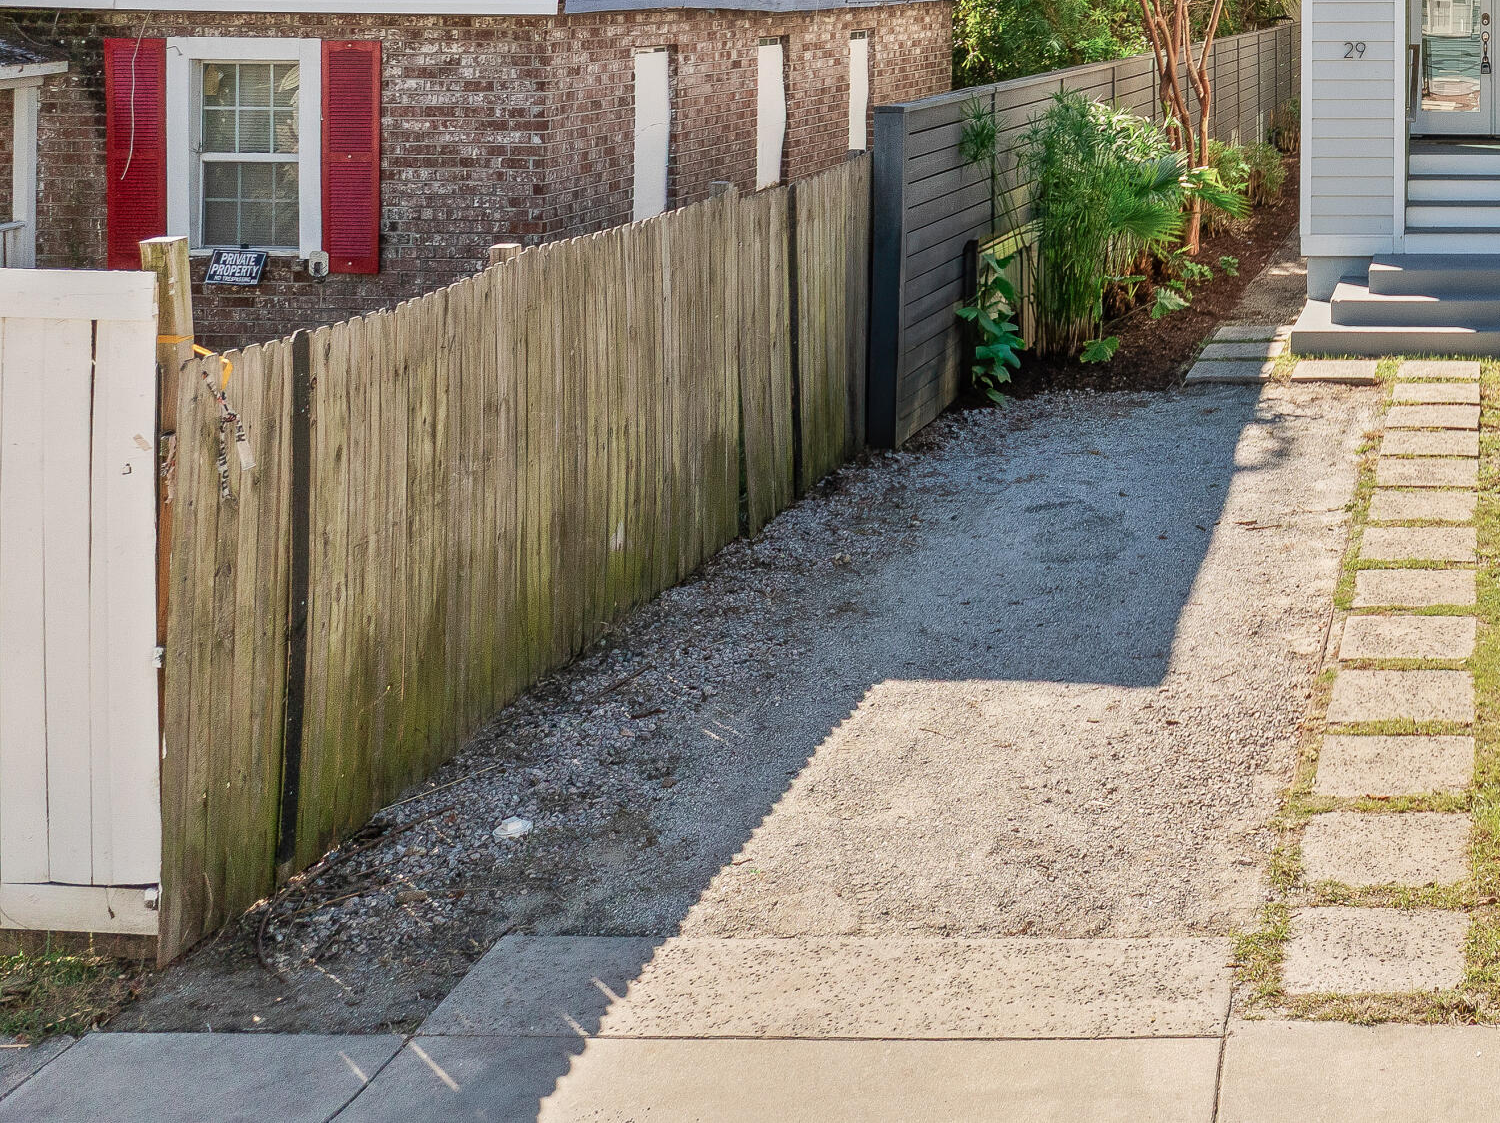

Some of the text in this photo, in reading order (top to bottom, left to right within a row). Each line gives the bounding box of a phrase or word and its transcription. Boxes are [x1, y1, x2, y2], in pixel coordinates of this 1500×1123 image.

[1343, 42, 1367, 59] 29
[219, 252, 258, 266] PRIVATE
[210, 263, 260, 277] PROPERTY
